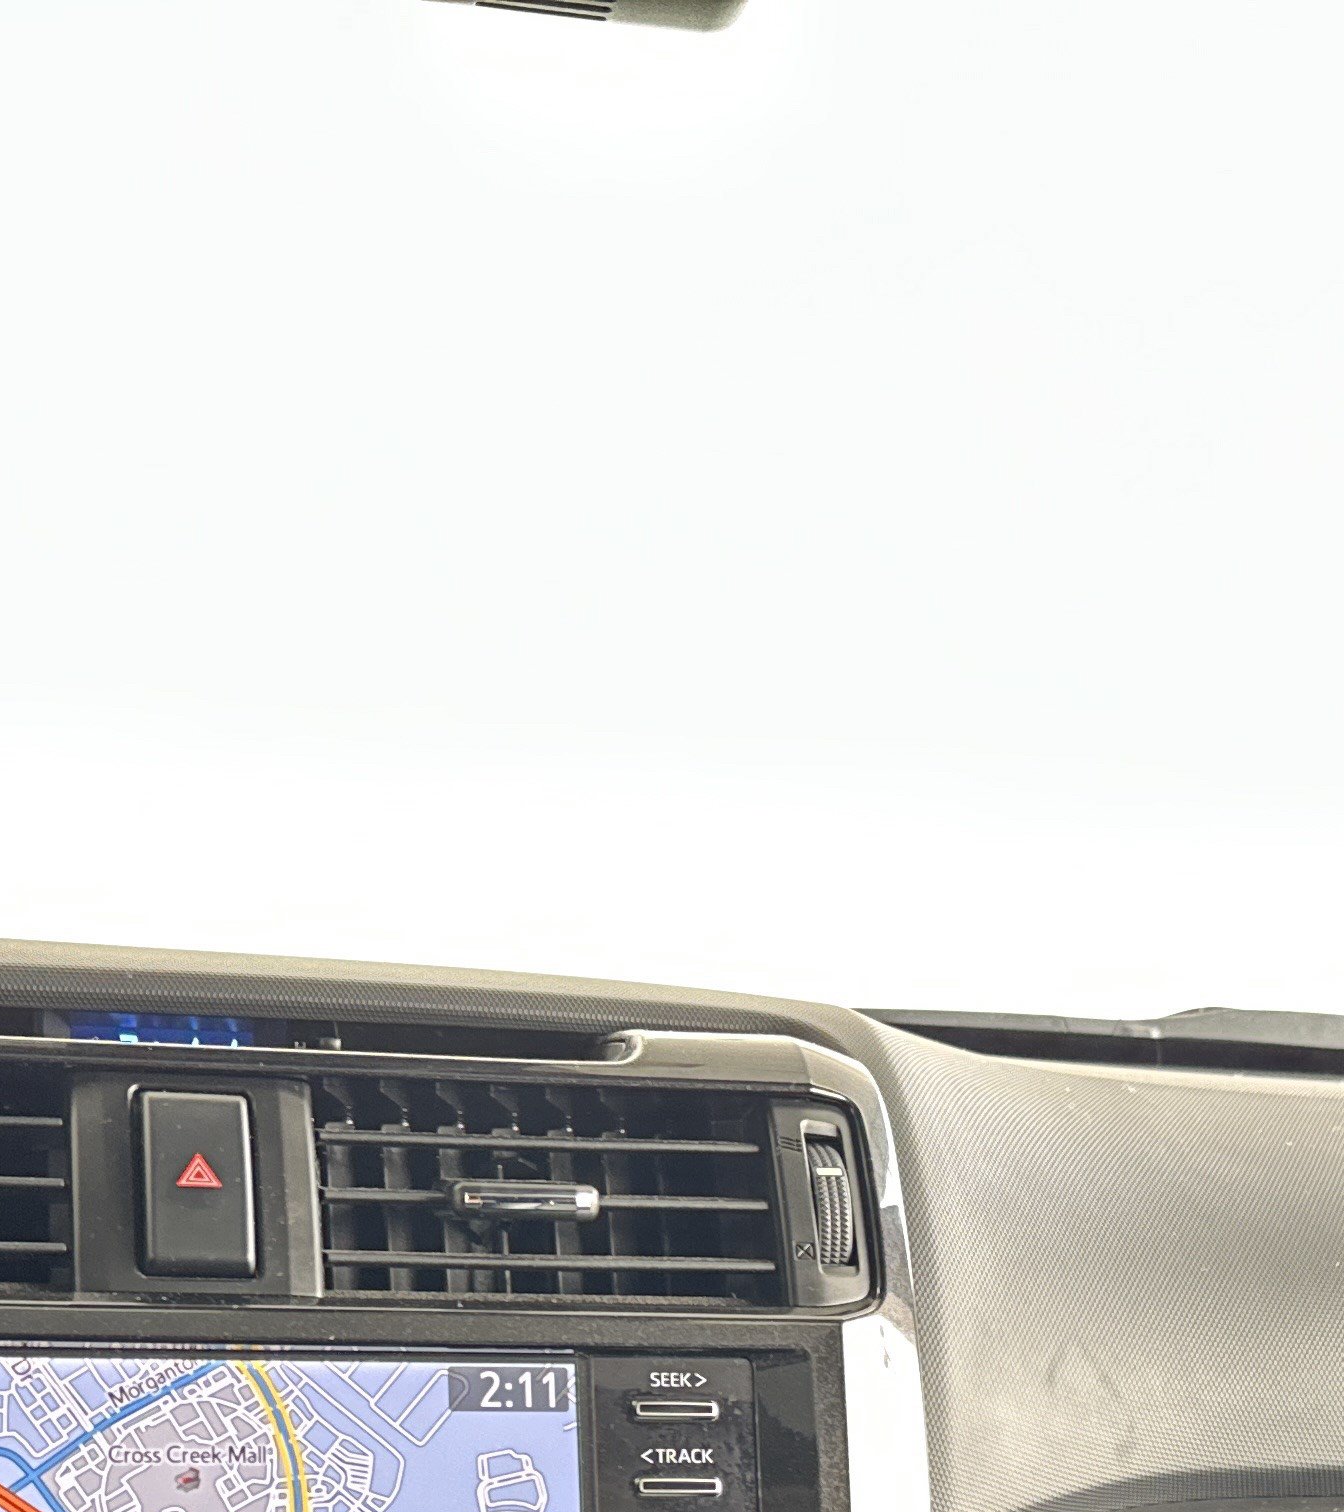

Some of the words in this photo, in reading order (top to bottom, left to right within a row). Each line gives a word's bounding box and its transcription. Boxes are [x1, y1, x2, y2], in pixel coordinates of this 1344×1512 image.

[478, 1370, 557, 1409] 2:11
[108, 1445, 162, 1464] Cross
[166, 1445, 222, 1464] Creek
[228, 1445, 267, 1464] Mall
